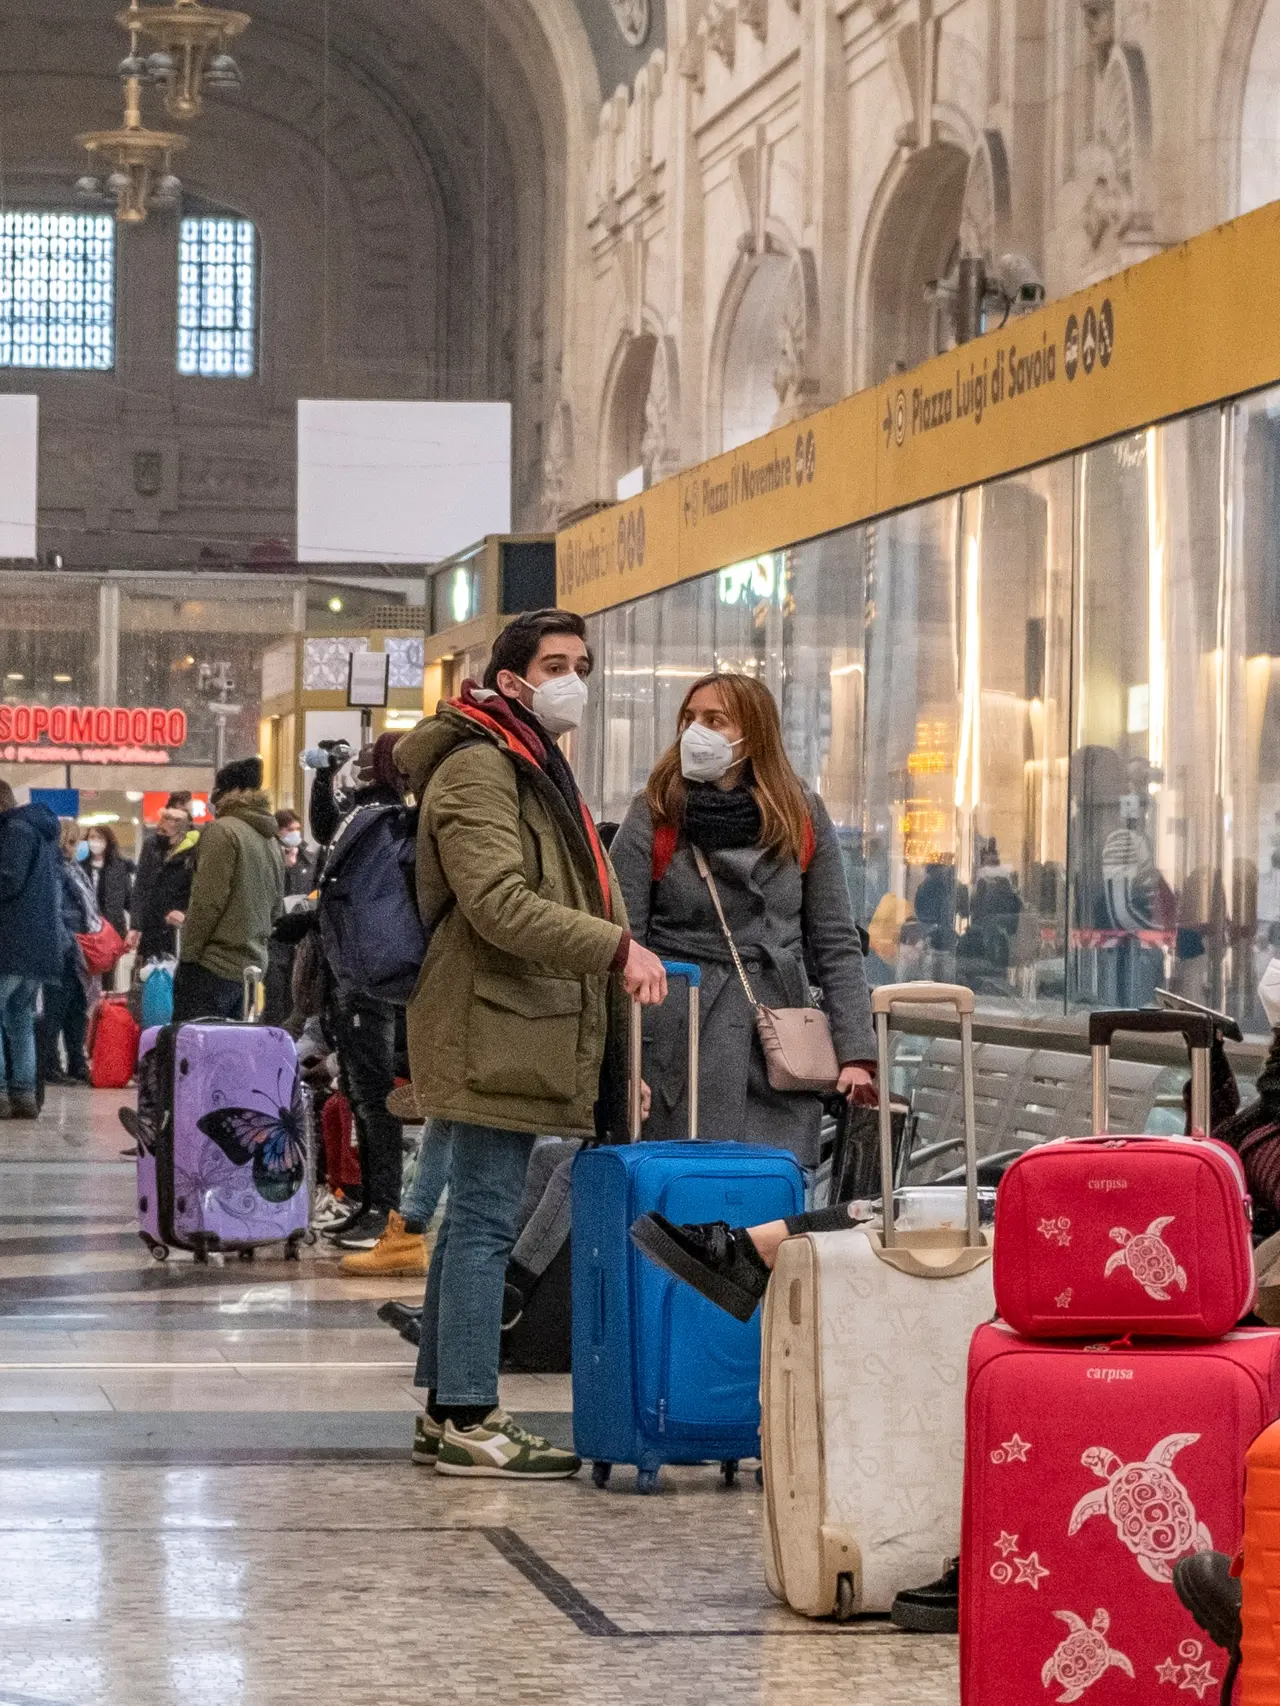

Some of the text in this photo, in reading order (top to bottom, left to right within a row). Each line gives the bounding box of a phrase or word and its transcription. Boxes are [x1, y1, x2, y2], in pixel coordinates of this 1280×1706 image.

[912, 330, 1056, 436] Piazza Luigi di Savoia
[702, 478, 729, 517] Piazza
[741, 450, 792, 501] Novembre
[1088, 1179, 1128, 1192] carpisa
[1086, 1367, 1134, 1383] carpisa
